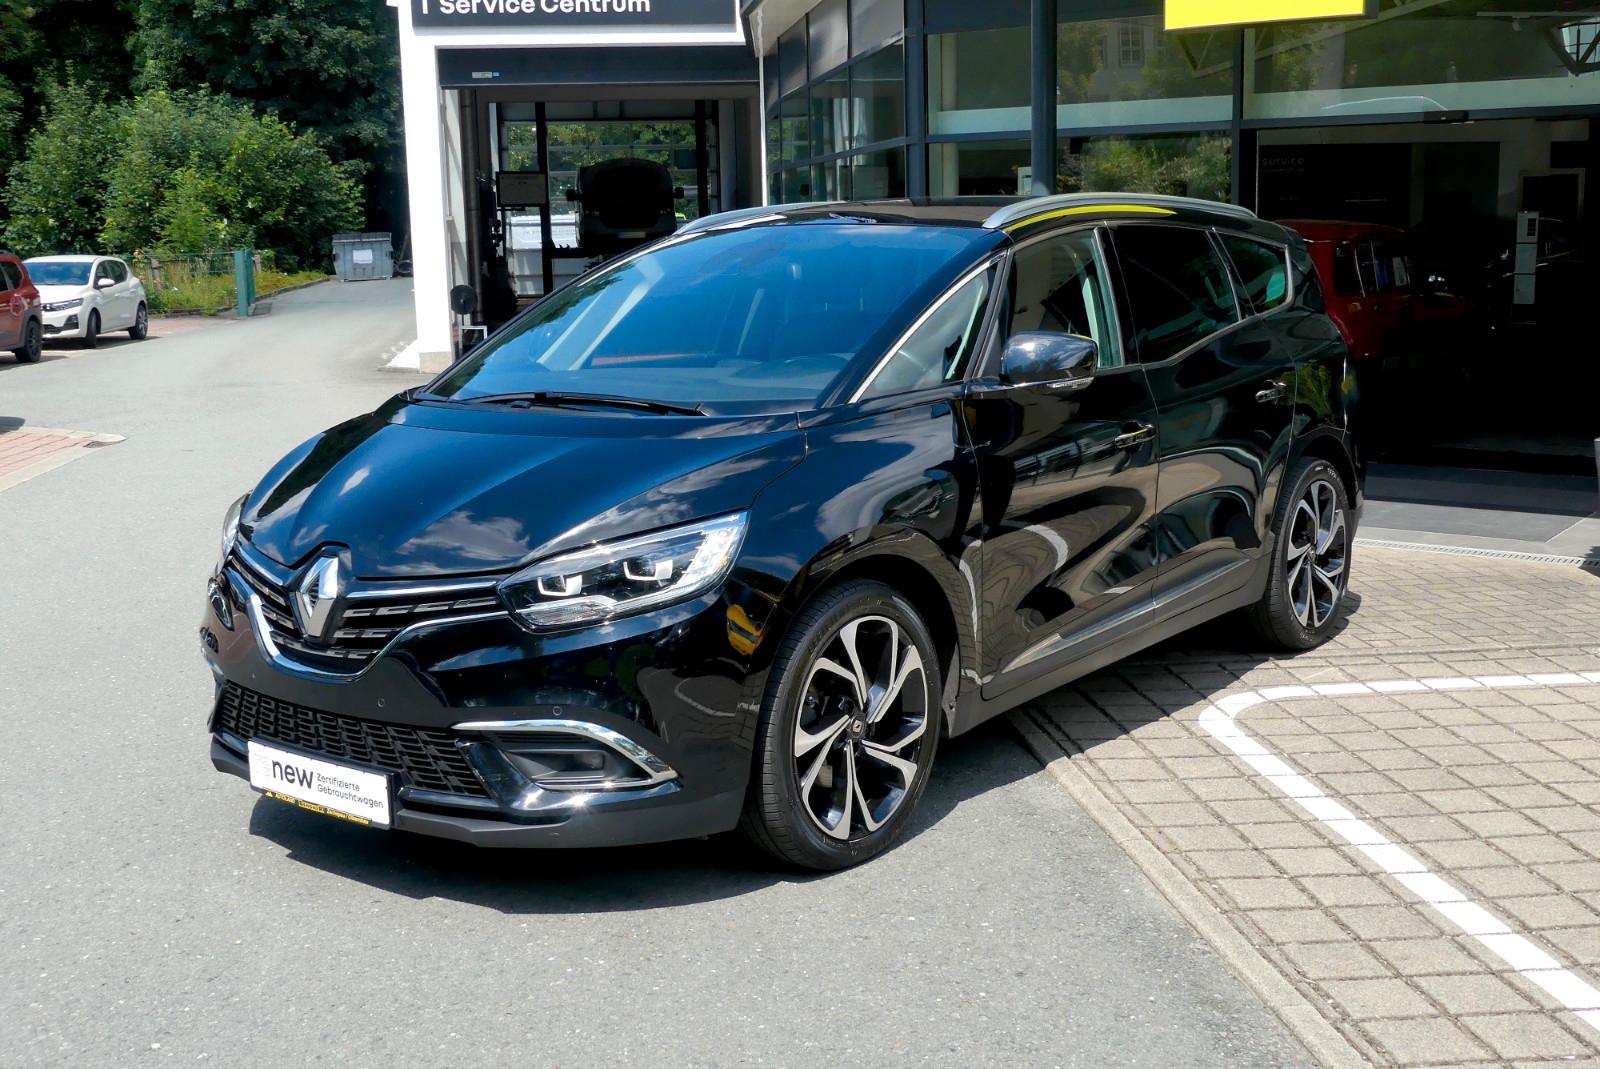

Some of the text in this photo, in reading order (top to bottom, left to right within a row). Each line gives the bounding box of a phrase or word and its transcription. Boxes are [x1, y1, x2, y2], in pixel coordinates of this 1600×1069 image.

[439, 0, 535, 14] Service
[540, 0, 651, 13] Centrum
[317, 773, 360, 791] Zertifizierte
[317, 784, 384, 808] Gebrauchtwagen
